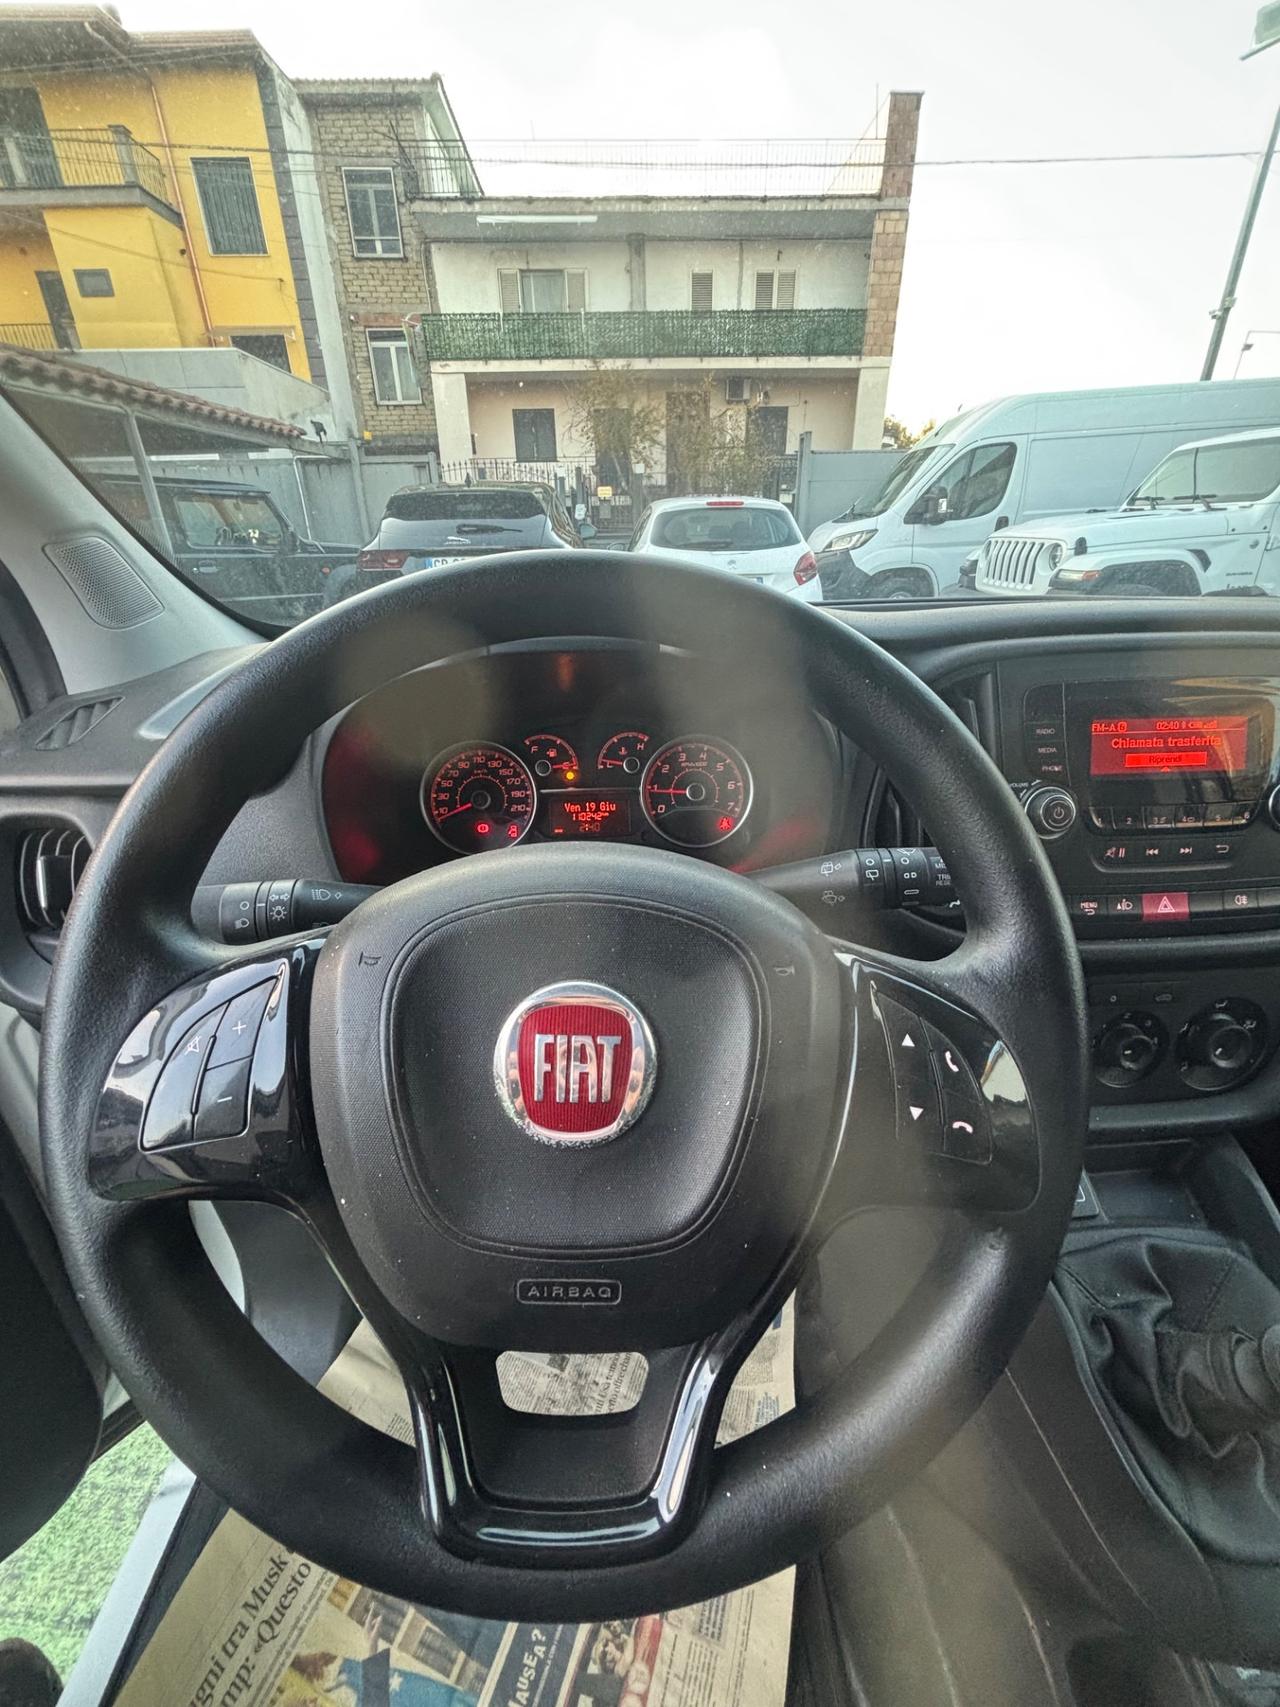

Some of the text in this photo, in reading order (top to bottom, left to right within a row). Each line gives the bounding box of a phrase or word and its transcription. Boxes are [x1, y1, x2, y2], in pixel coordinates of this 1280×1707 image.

[637, 742, 645, 751] H
[1111, 736, 1222, 749] Chiamata trasferita
[531, 745, 538, 754] F
[678, 753, 687, 761] 3
[700, 752, 707, 760] 4
[458, 761, 470, 769] 90
[488, 760, 503, 768] 130
[716, 763, 724, 771] 5
[499, 768, 514, 776] 150
[661, 764, 670, 773] 2
[449, 770, 459, 778] 70
[441, 780, 453, 788] 50
[727, 781, 736, 790] 6
[438, 792, 450, 800] 30
[511, 790, 526, 798] 190
[511, 804, 526, 812] 210
[564, 801, 616, 812] Ven 19 Giu
[657, 804, 666, 813] 0
[727, 802, 735, 810] 7
[1080, 901, 1098, 909] MENU
[533, 1033, 622, 1104] FIAT
[528, 1286, 611, 1298] AIRBAG
[253, 1562, 311, 1654] «Questo
[190, 1553, 289, 1707] gni tra Musk
